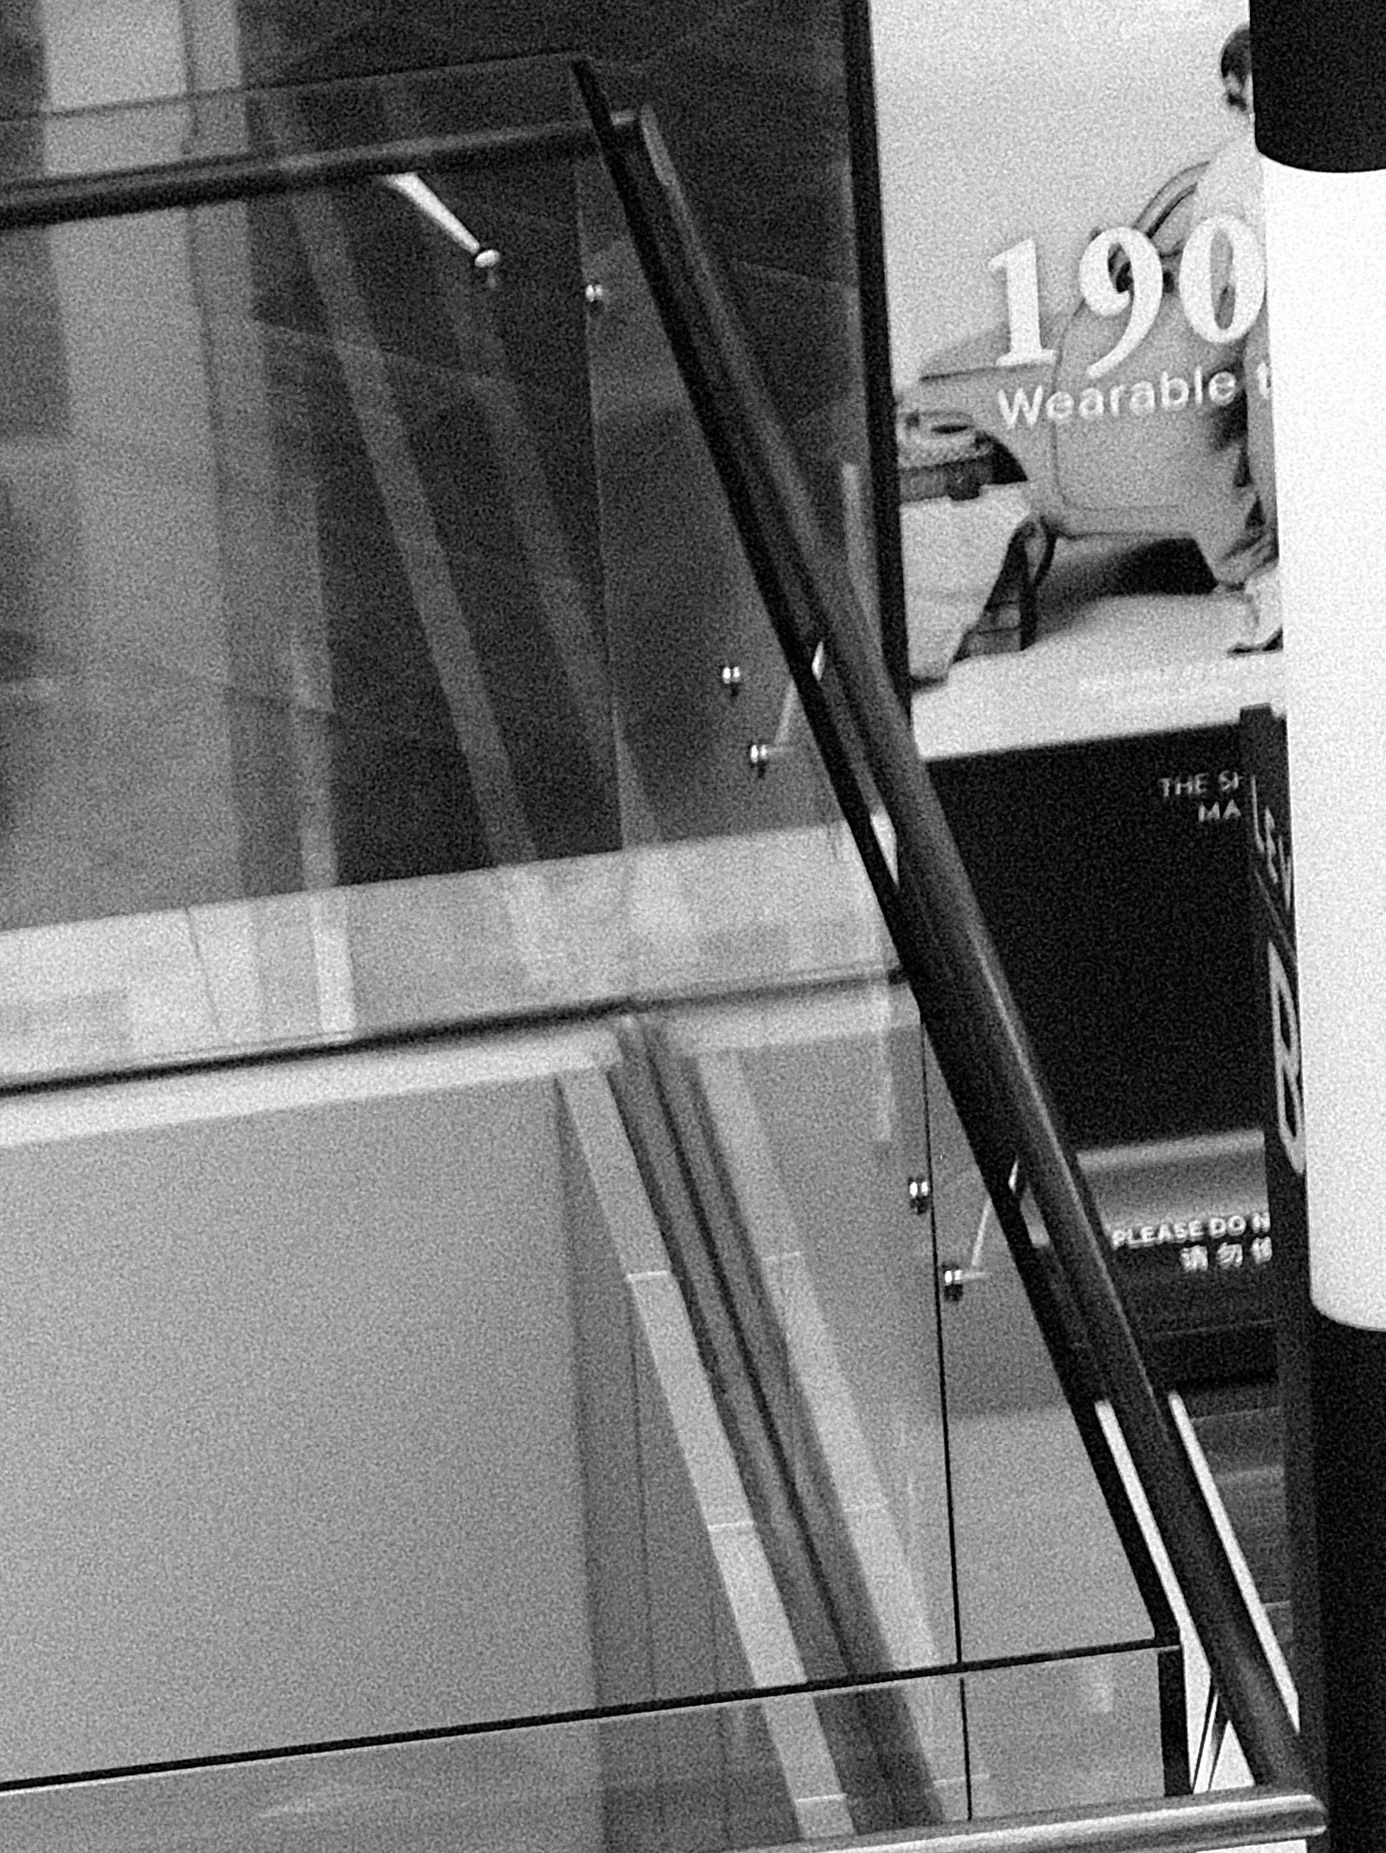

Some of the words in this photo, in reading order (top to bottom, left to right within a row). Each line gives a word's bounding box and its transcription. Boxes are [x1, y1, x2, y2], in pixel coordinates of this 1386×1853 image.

[996, 365, 1238, 431] Wearable
[1157, 771, 1210, 797] THE
[1111, 1218, 1205, 1250] PLEASE
[1208, 1214, 1247, 1239] DO
